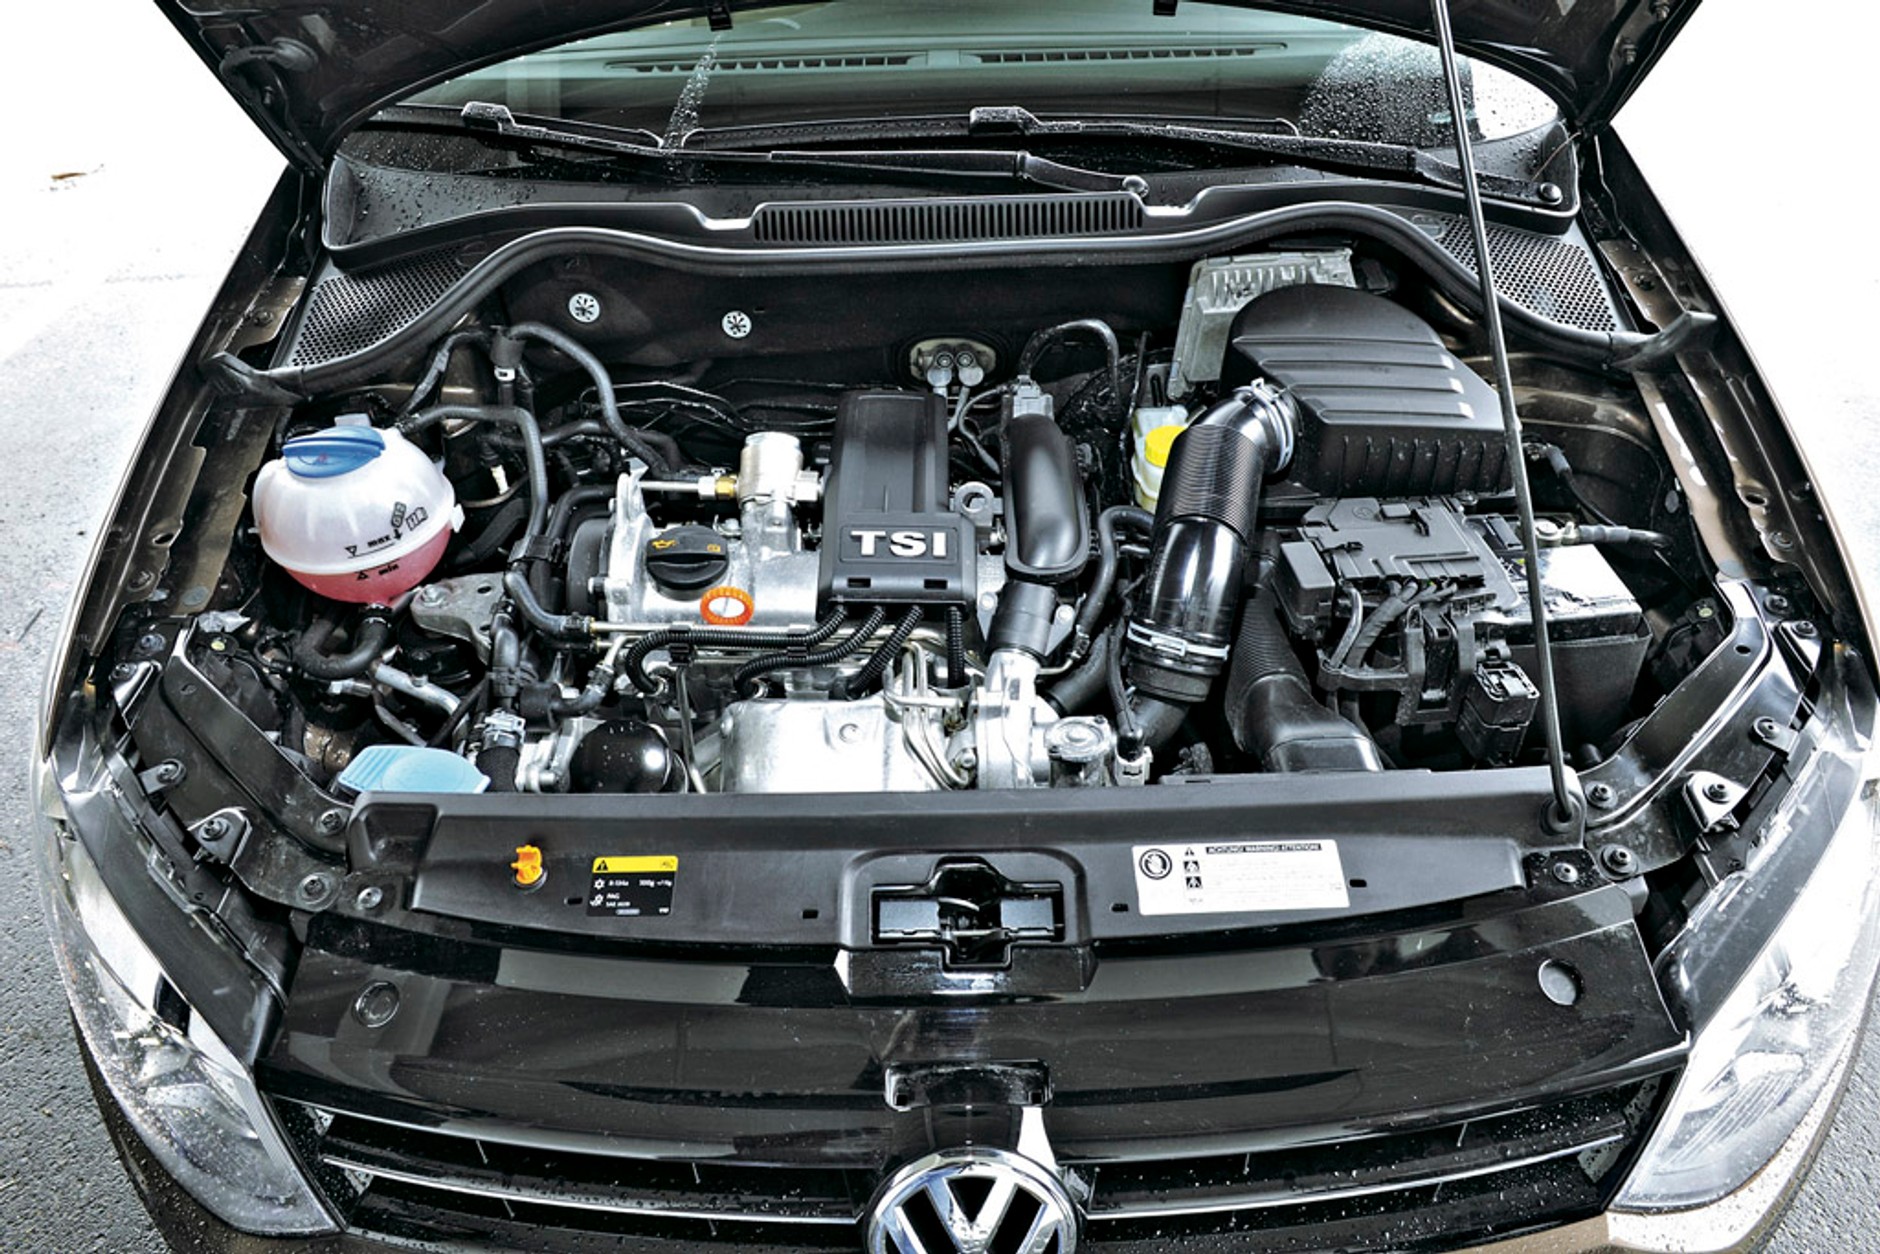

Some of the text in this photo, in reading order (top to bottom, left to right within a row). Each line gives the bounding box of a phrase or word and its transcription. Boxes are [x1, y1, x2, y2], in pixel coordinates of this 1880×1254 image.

[367, 535, 392, 548] max
[850, 530, 947, 558] TSI
[378, 563, 399, 576] min
